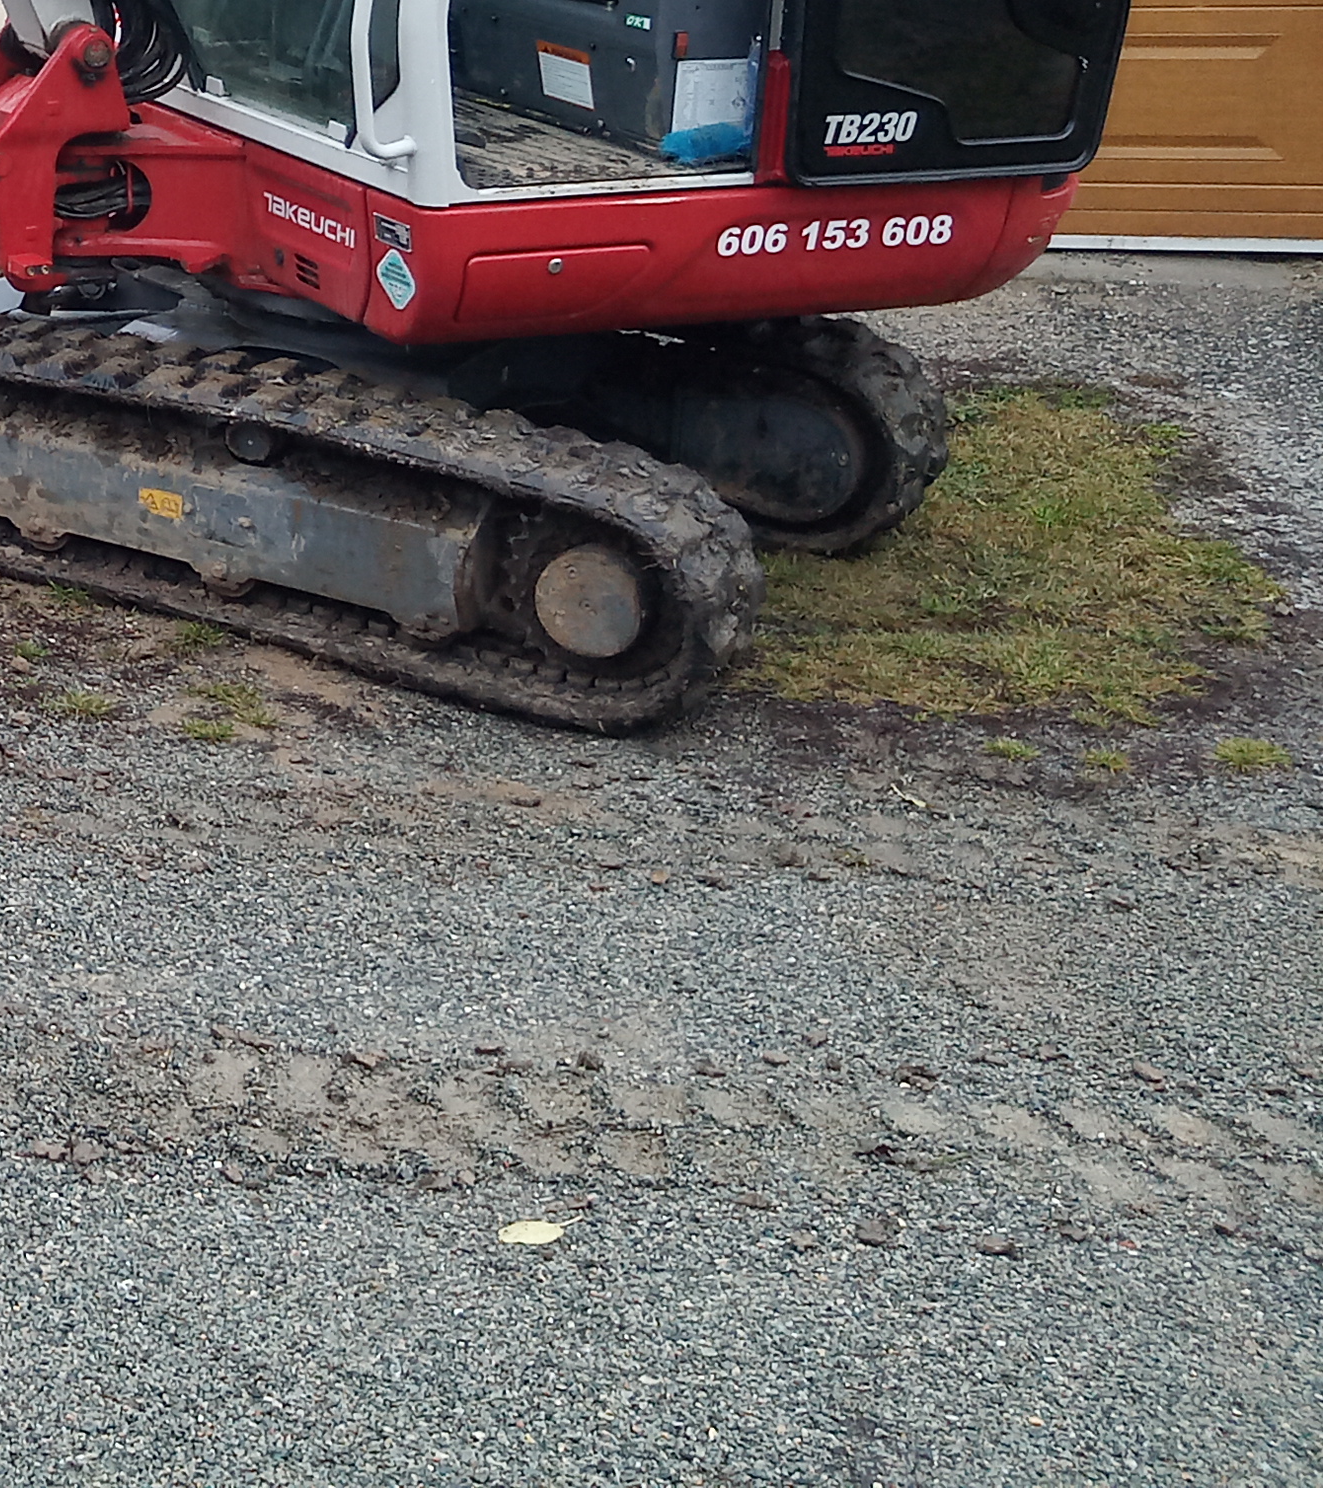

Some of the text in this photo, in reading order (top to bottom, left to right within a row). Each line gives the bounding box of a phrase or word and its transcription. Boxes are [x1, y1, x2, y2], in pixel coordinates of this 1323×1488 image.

[823, 110, 919, 145] TB230
[716, 214, 954, 257] 606 153 608
